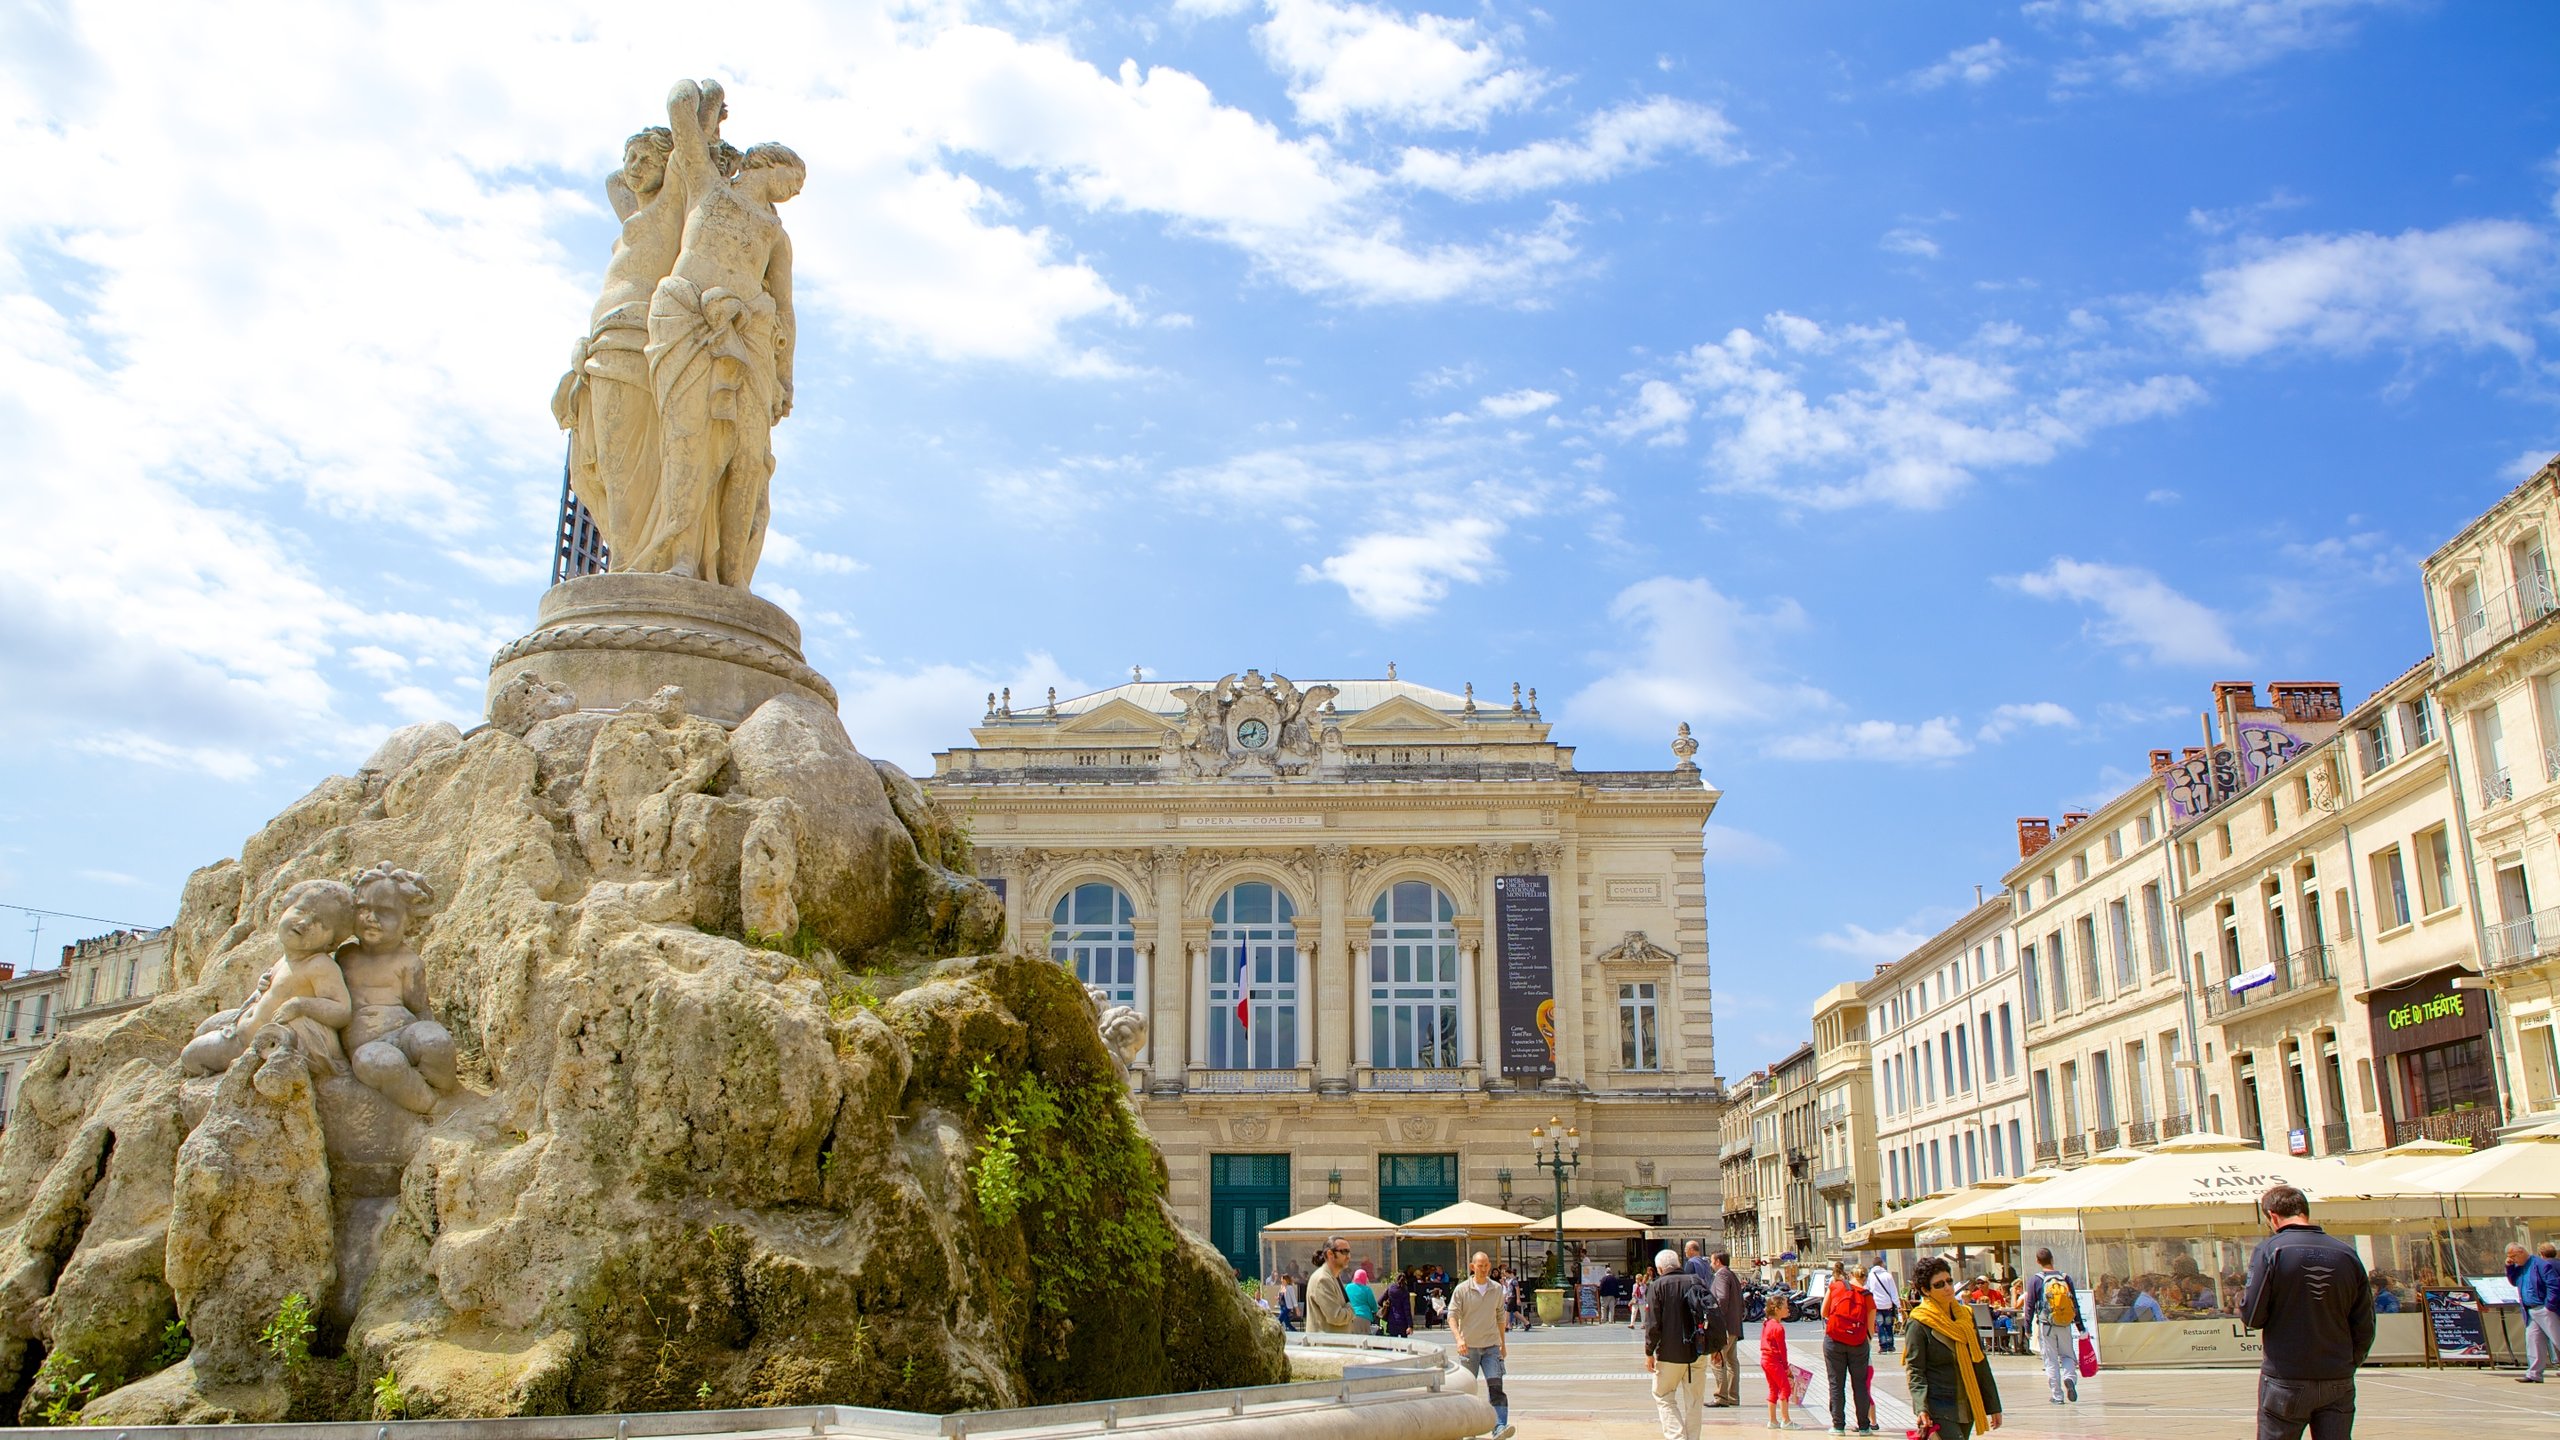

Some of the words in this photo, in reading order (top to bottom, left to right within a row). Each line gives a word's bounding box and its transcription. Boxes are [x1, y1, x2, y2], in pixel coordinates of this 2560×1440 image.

[1196, 817, 1234, 825] OPERA
[1253, 816, 1305, 825] COMEDIE
[2388, 1002, 2412, 1030] CAFÉ
[2412, 1004, 2423, 1024] DU
[2218, 1165, 2242, 1174] LE
[2193, 1174, 2288, 1188] YAM'S
[2189, 1189, 2248, 1198] Service
[2240, 1342, 2263, 1352] Serv
